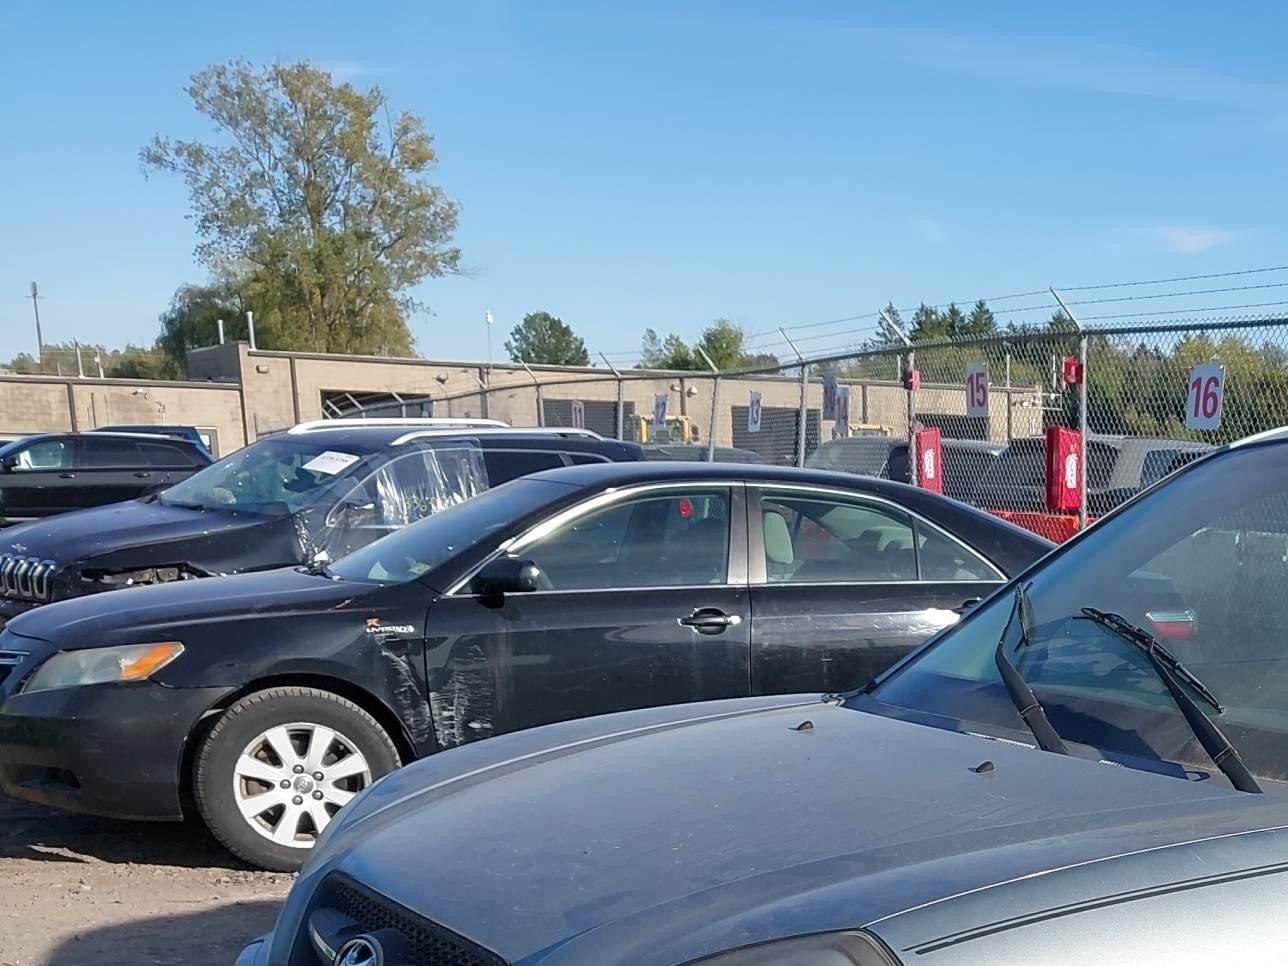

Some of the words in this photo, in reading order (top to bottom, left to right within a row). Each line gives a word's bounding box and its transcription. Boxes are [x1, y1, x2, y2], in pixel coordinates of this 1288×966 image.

[967, 372, 986, 407] 15
[1191, 376, 1220, 420] 16
[655, 401, 666, 425] 12
[751, 399, 761, 425] 13
